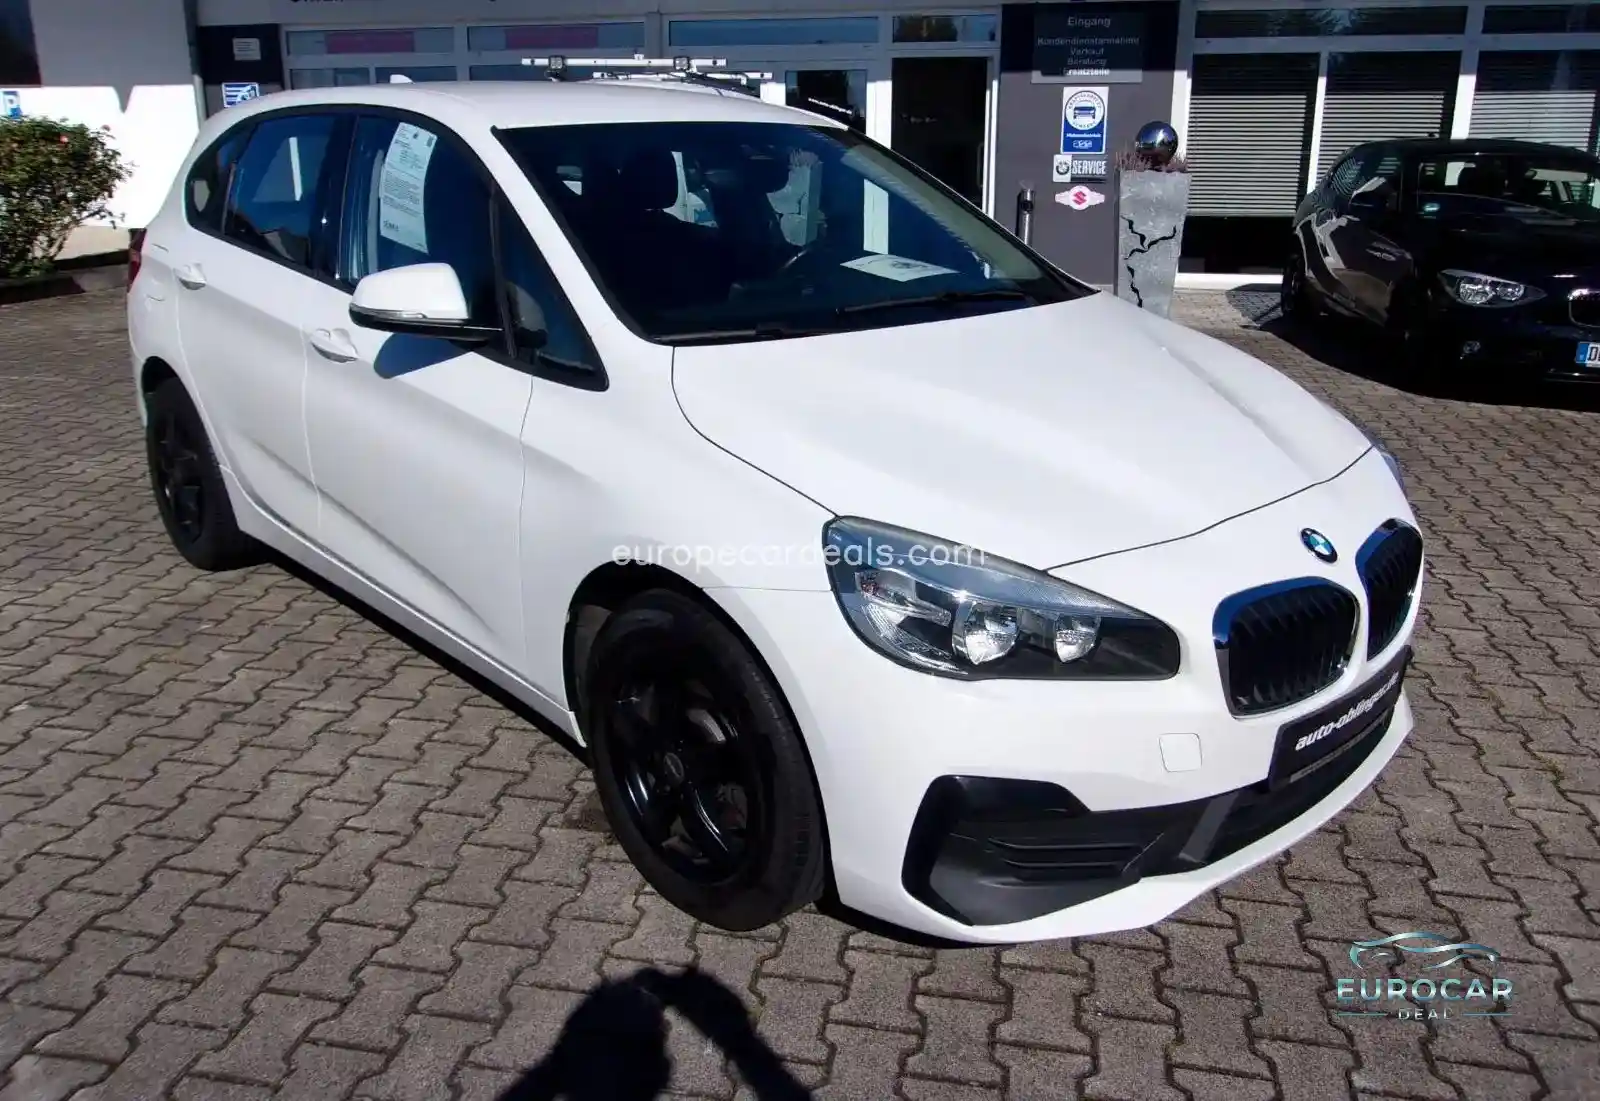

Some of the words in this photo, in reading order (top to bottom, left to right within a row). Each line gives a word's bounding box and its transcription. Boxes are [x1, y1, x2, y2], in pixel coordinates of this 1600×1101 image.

[1067, 16, 1111, 28] Eingang
[1070, 47, 1105, 56] Verkauf
[1071, 159, 1107, 175] SERVICE
